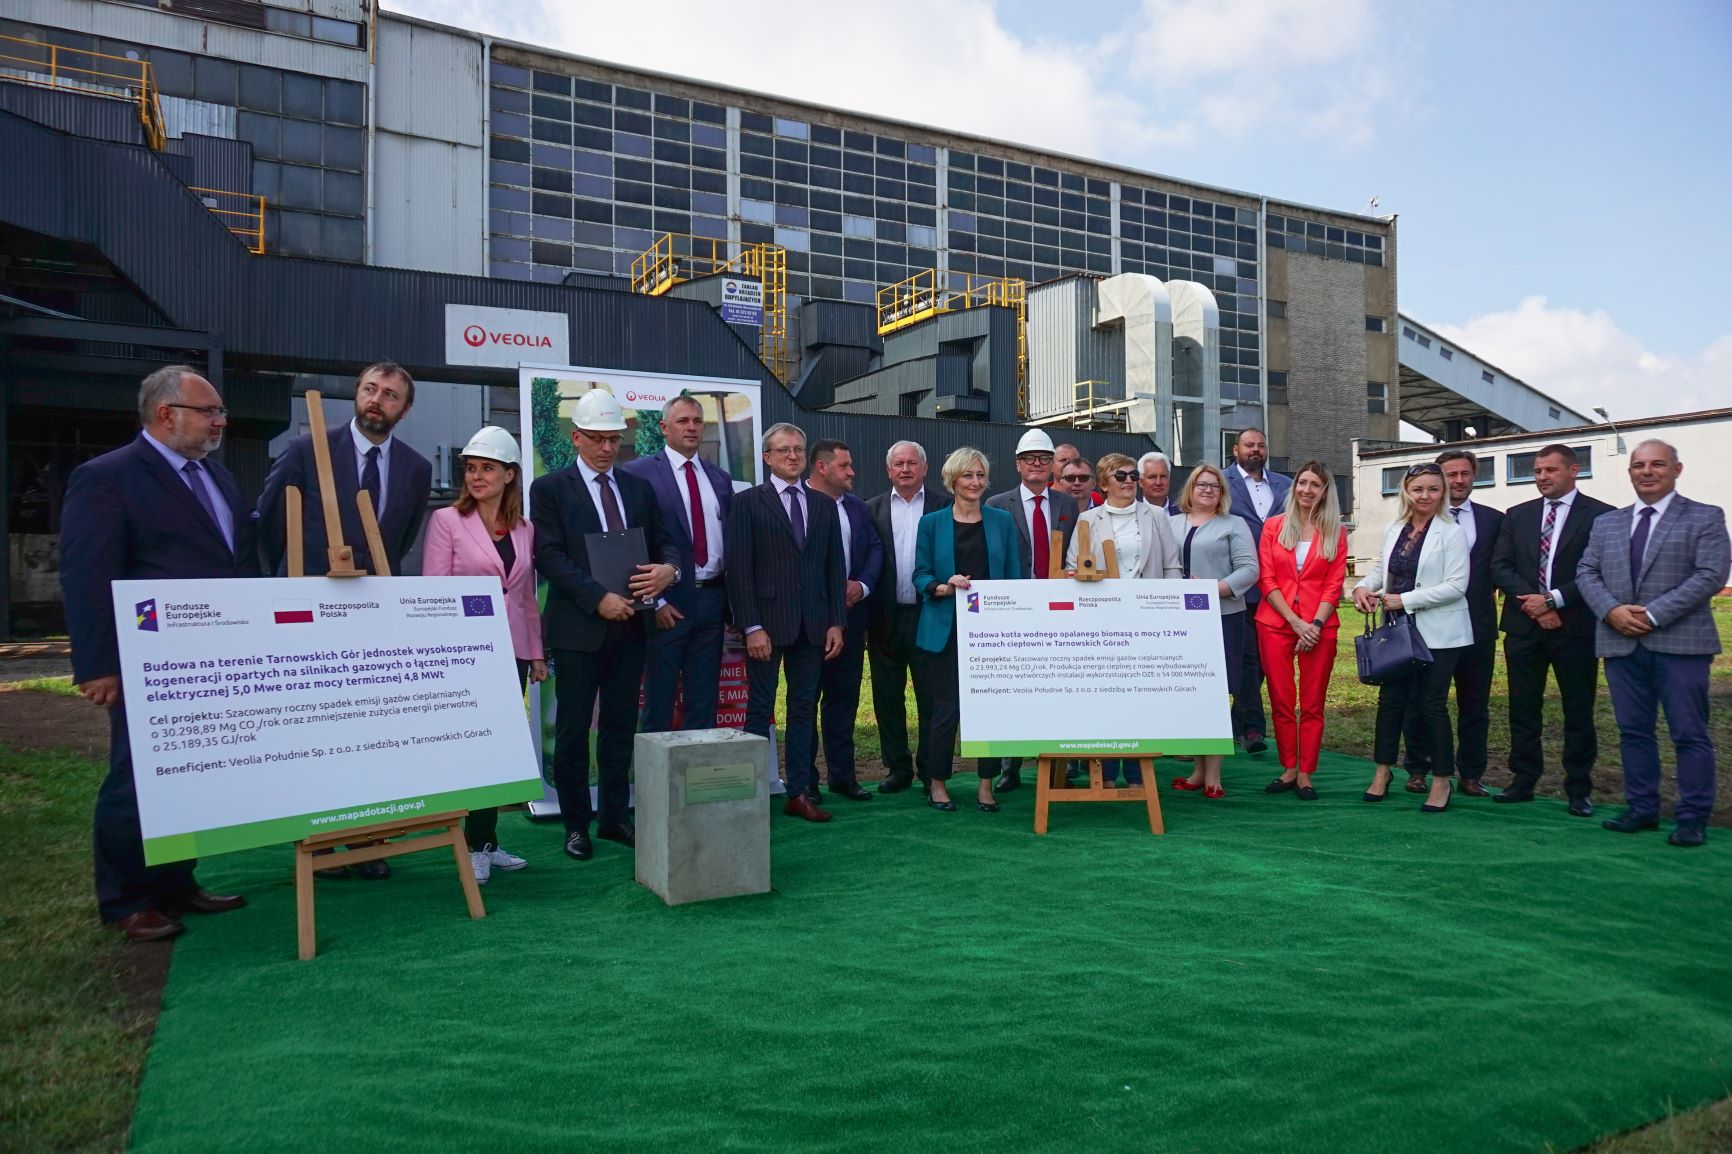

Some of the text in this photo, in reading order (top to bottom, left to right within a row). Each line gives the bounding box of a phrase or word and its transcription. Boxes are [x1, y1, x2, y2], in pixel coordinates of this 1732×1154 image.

[489, 332, 552, 348] VEOLIA
[165, 603, 209, 611] Fundusze
[319, 602, 379, 610] Rzeczpospolita
[417, 597, 456, 605] Europejska
[166, 610, 222, 619] Europejskie
[320, 610, 347, 618] Polska
[1023, 631, 1058, 640] wodnego
[1060, 630, 1100, 639] opalanego
[1101, 630, 1132, 638] biomasą
[1007, 640, 1044, 649] ciepłowni
[1103, 639, 1129, 647] Górach
[143, 642, 494, 672] Budowa na terenie Tarnowskich Gór jednostek wysokosprawnej
[145, 672, 222, 687] kogeneracji
[225, 668, 280, 683] opartych
[283, 668, 297, 677] na
[300, 663, 350, 676] silnikach
[353, 660, 403, 674] gazowych
[413, 658, 449, 670] łącznej
[451, 656, 476, 667] mocy
[147, 670, 445, 702] elektrycznej 5,0 Mwe oraz mocy termicznej 4,8 MWt
[970, 687, 1012, 695] Beneficjent:
[150, 688, 471, 726] Cel projektu: Szacowany roczny spadek emisji gazów cieplarnianych
[162, 724, 216, 738] 30.298,89
[219, 723, 237, 733] Mg
[283, 715, 304, 725] oraz
[307, 711, 366, 723] zmniejszenie
[369, 708, 400, 719] zużycia
[402, 703, 432, 715] energii
[434, 699, 478, 712] pierwotnej
[163, 737, 218, 751] 25.189,35
[221, 733, 257, 745] GJ/rok
[156, 761, 227, 776] Beneficjent:
[229, 754, 262, 767] Veolia
[265, 748, 309, 762] Południe
[311, 747, 327, 758] Sp.
[336, 746, 354, 754] o.o.
[363, 739, 400, 751] siedzibą
[411, 730, 462, 745] Tarnowskich
[464, 728, 492, 739] Górach
[311, 800, 425, 825] www.mapadotacji.gov.pl
